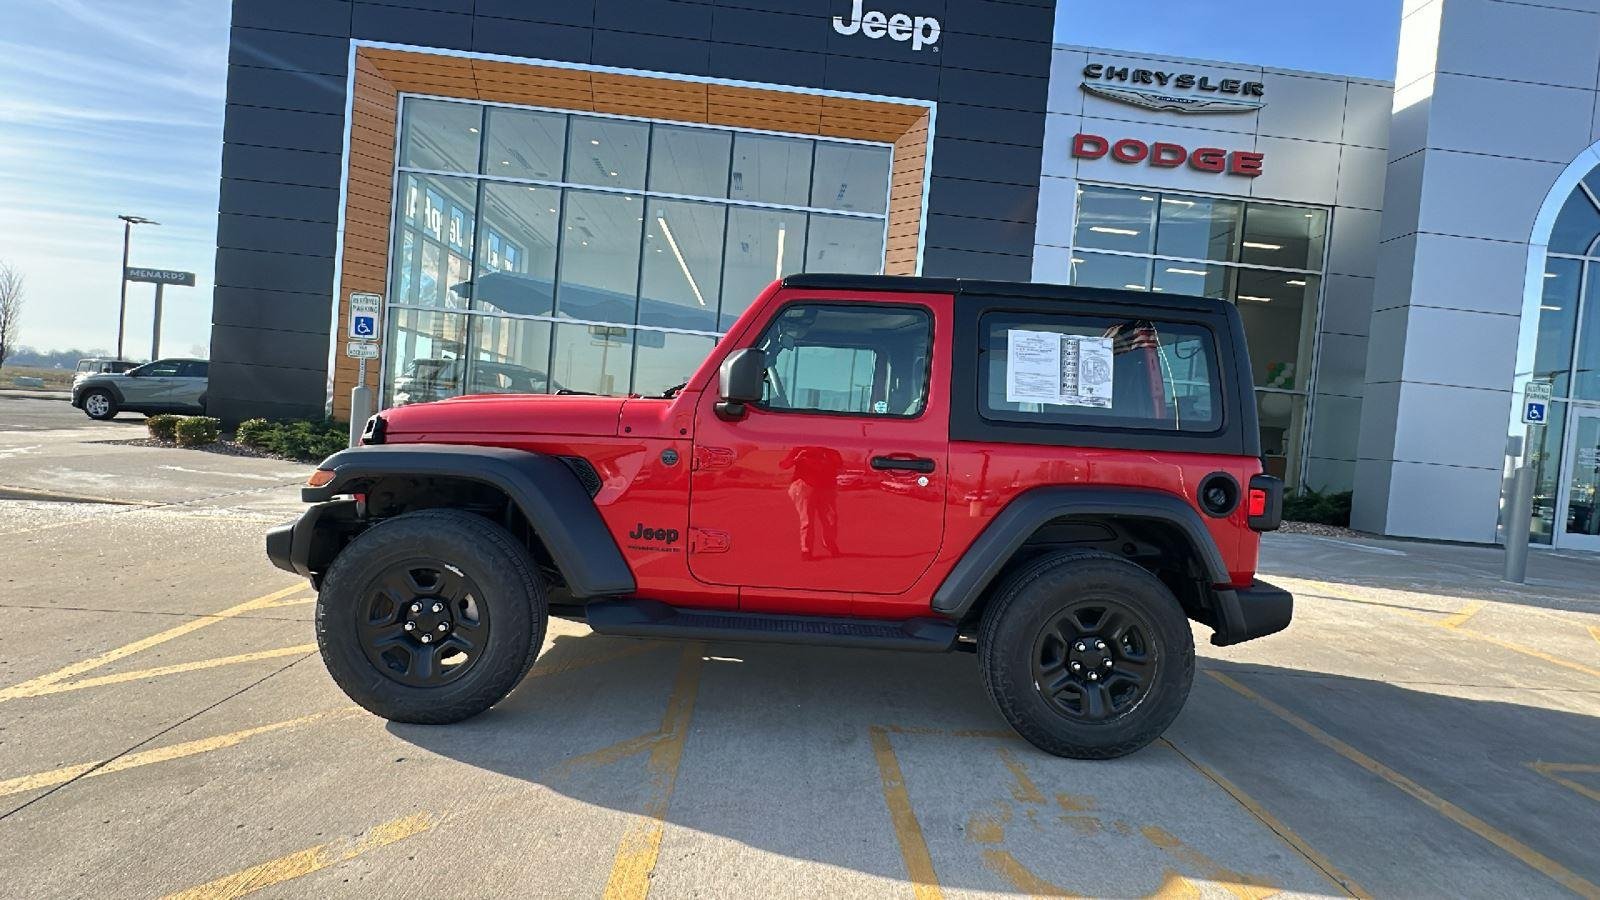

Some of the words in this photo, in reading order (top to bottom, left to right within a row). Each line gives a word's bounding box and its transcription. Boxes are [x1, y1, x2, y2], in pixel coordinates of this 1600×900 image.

[832, 0, 941, 51] Jeep
[1083, 63, 1265, 96] CHRYSLER
[1073, 133, 1265, 177] DODGE
[129, 269, 185, 280] MENARDS
[629, 522, 679, 544] Jeep
